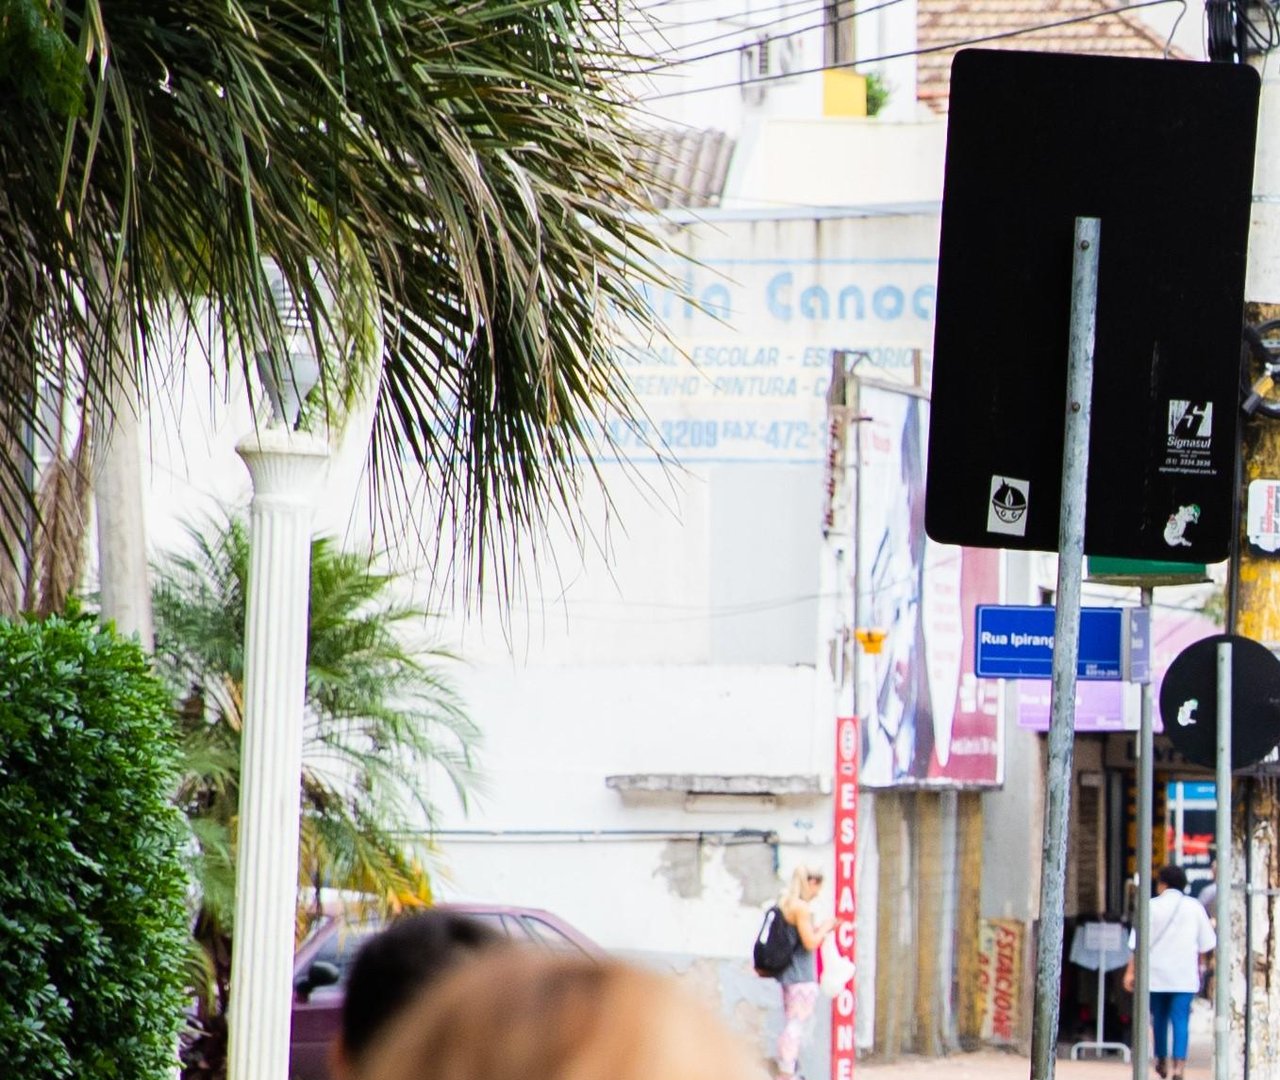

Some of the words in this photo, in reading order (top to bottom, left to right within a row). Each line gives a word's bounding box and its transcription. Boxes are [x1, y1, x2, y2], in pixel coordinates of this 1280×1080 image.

[692, 346, 779, 368] ESCOLAR
[1167, 436, 1211, 449] Signasul
[981, 631, 1008, 645] Rua
[1010, 631, 1054, 649] Ipirang
